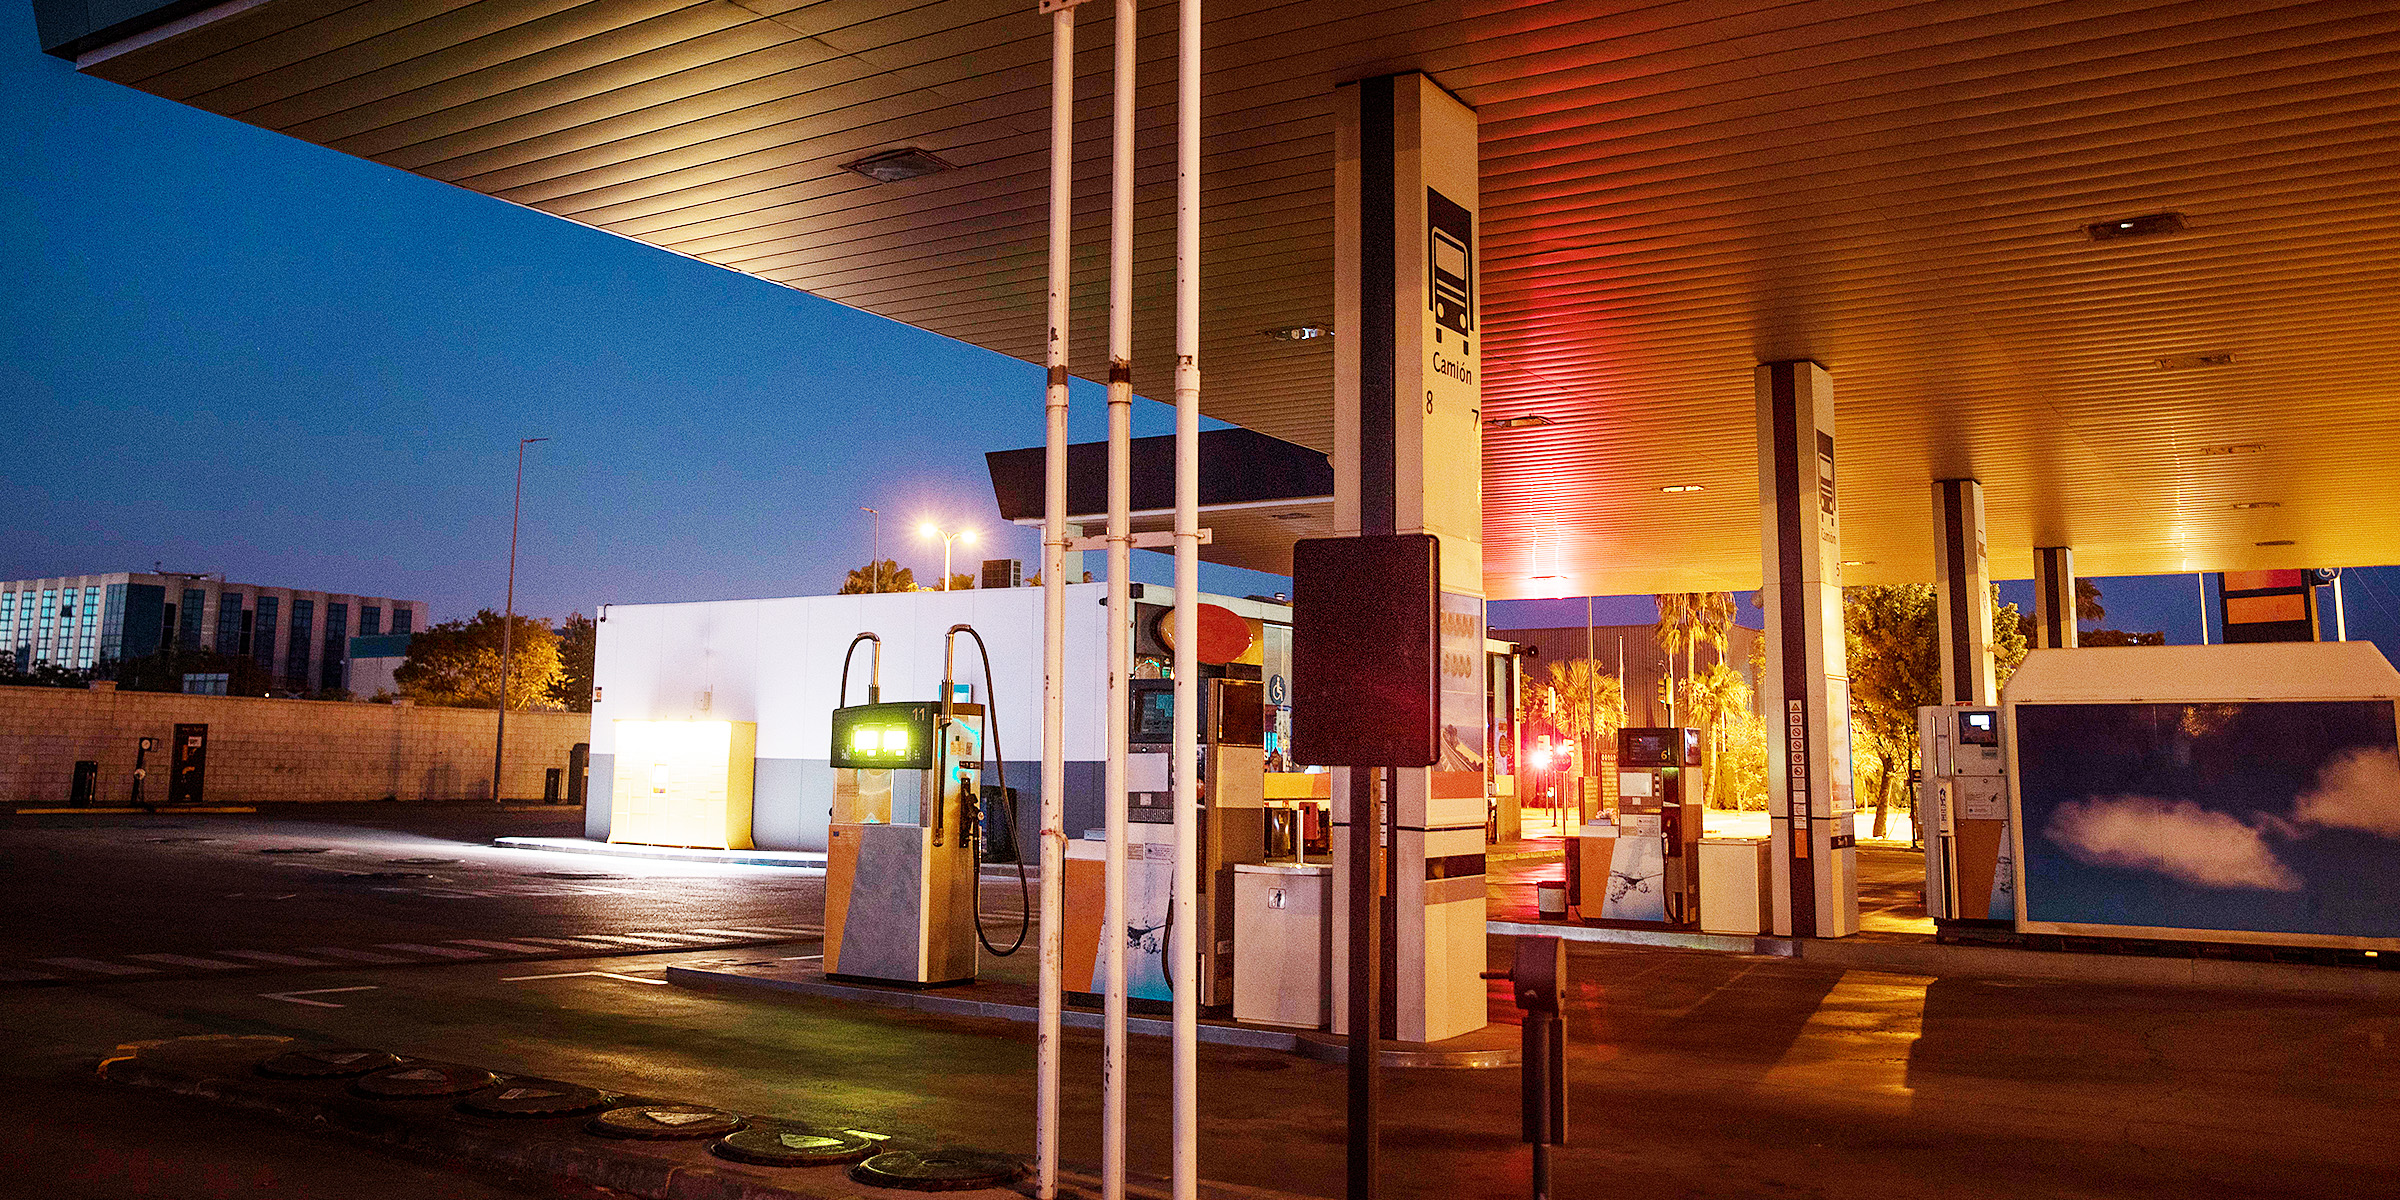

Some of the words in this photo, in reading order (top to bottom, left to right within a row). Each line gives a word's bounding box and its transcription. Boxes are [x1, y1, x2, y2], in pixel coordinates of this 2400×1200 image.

[1433, 351, 1472, 386] Camión
[1426, 390, 1433, 415] 8
[1471, 408, 1480, 432] 7
[912, 707, 926, 721] 11
[1660, 750, 1668, 760] 6
